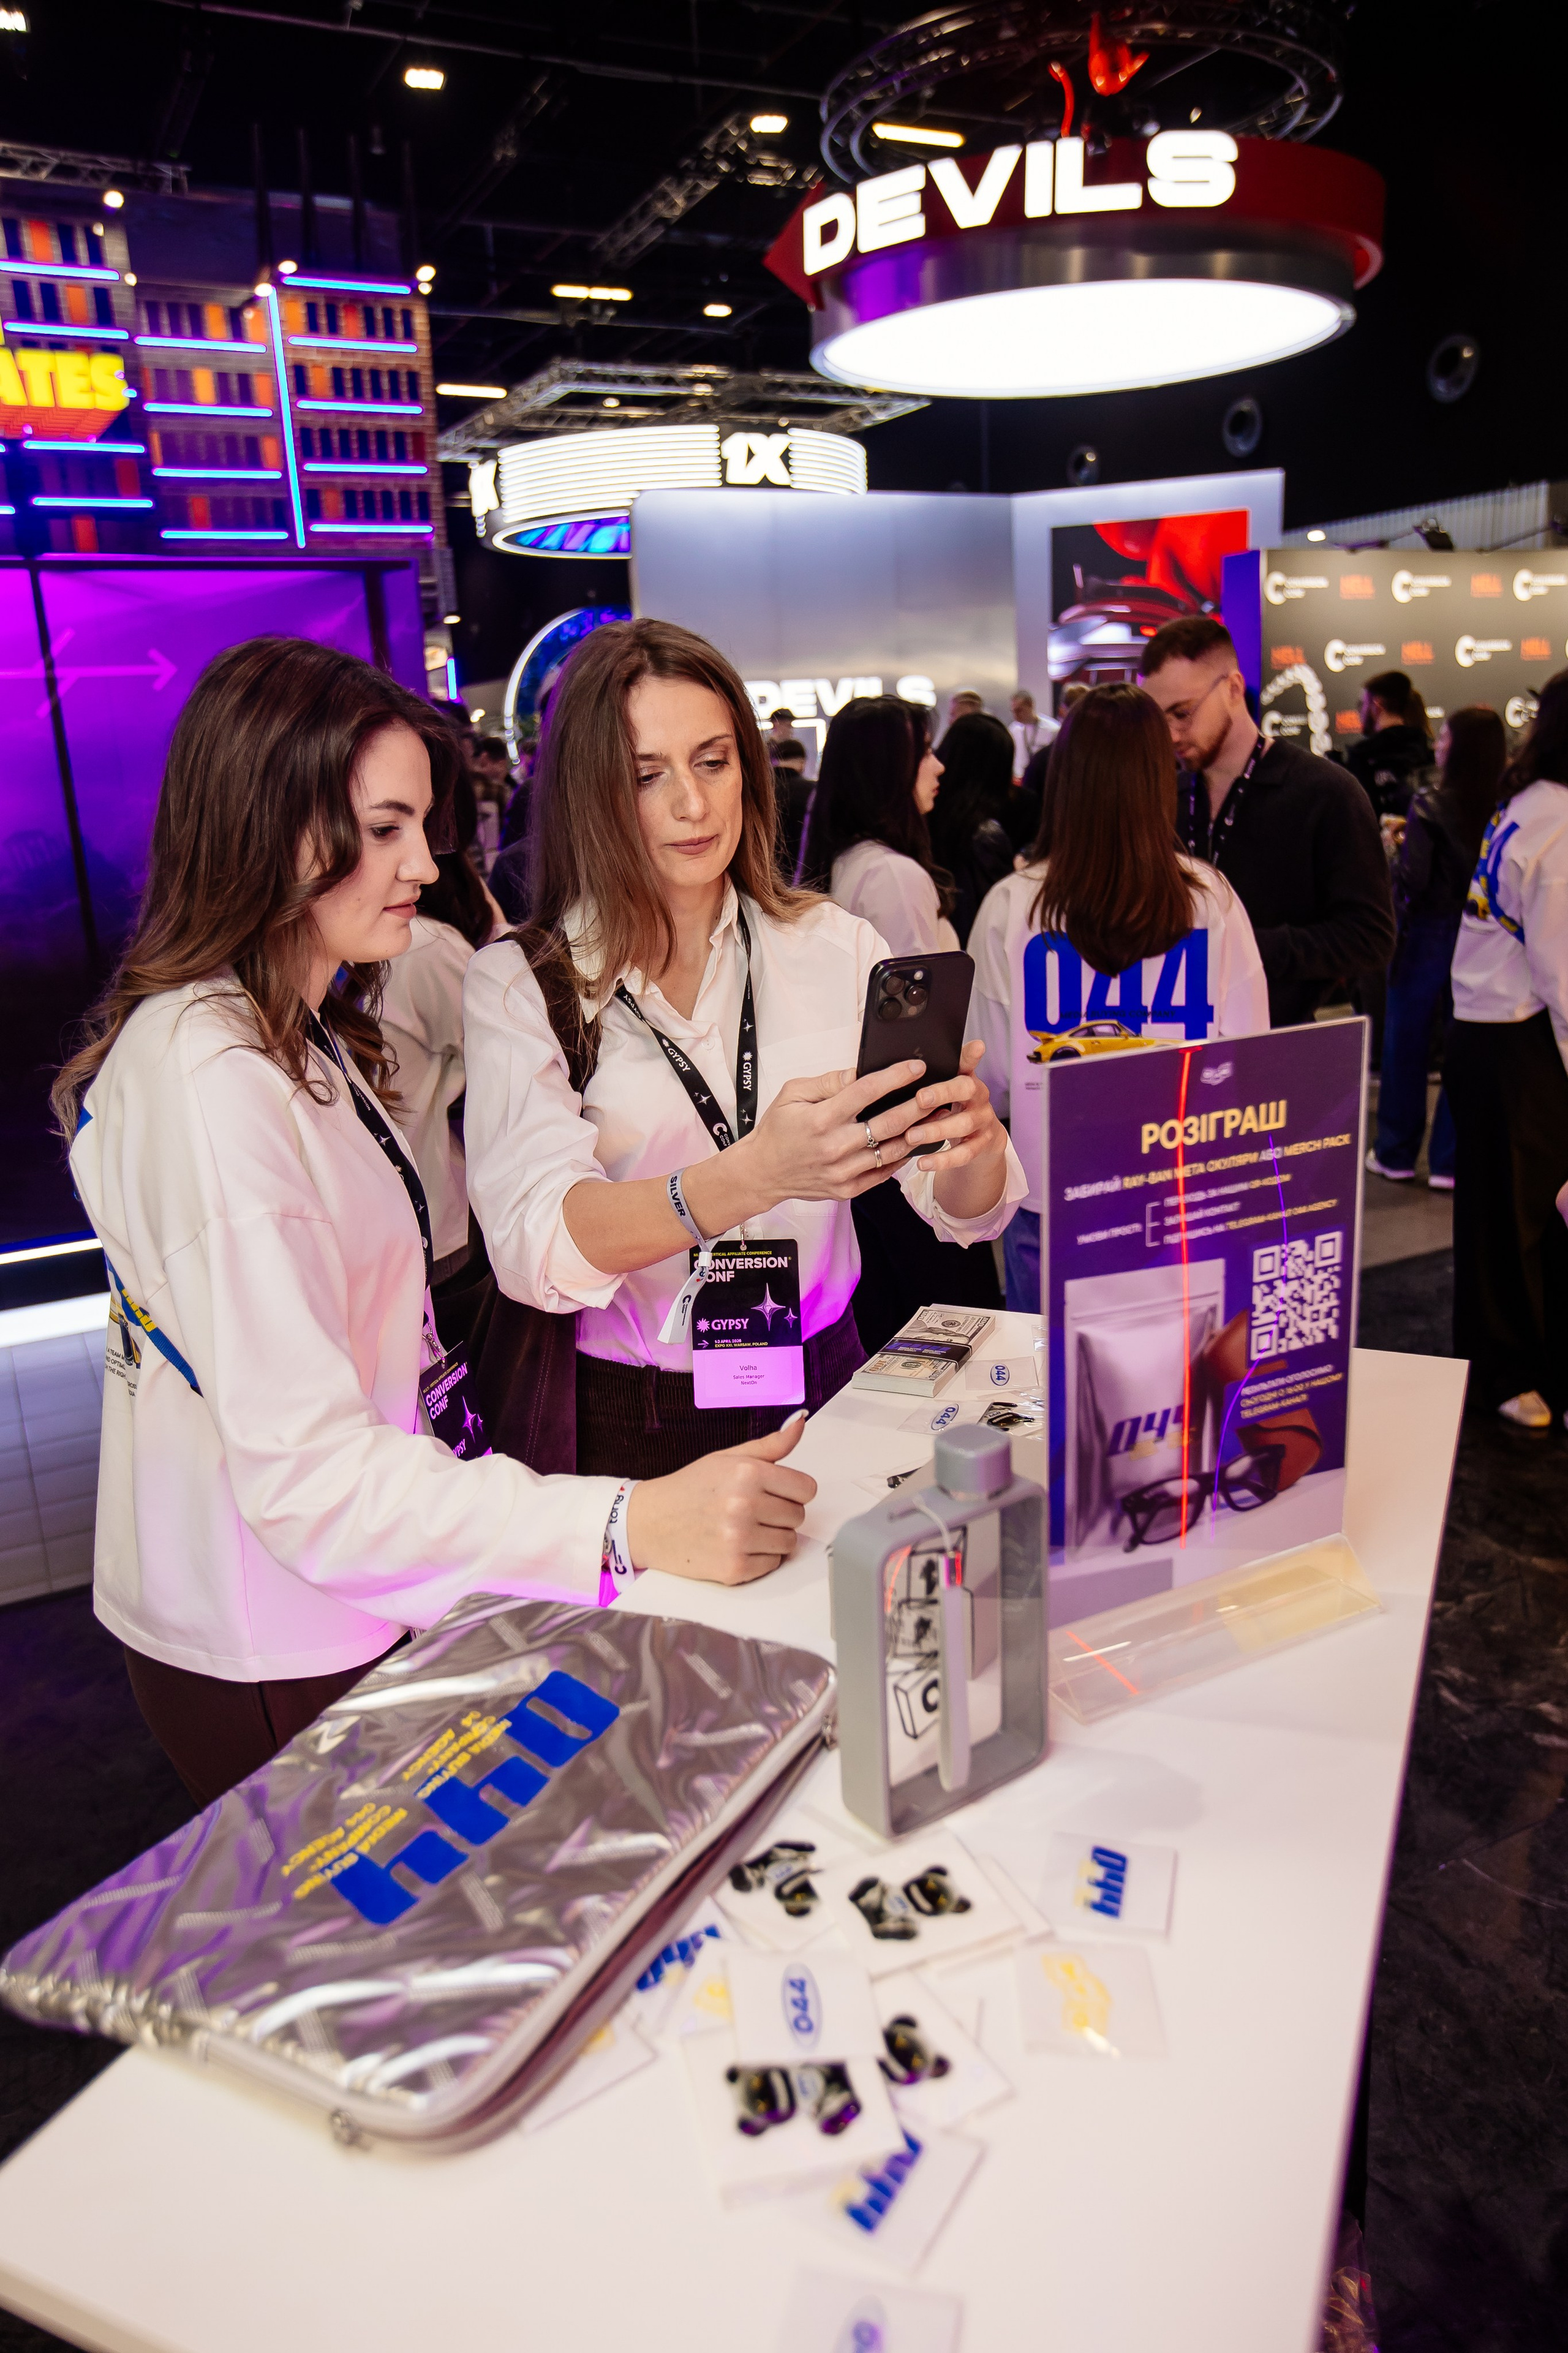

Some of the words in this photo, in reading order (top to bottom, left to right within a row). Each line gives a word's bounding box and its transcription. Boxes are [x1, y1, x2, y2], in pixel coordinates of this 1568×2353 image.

[802, 129, 1239, 276] DEVILS
[668, 1048, 691, 1072] GYPSY
[743, 1062, 752, 1091] GYPSY
[669, 1175, 686, 1217] SILVER
[705, 1271, 735, 1283] ONF
[711, 1318, 749, 1331] GYPSY
[110, 1349, 121, 1358] TEAM
[426, 1362, 468, 1407] CONVERSION
[995, 1365, 1006, 1381] 044
[429, 1395, 448, 1420] CONF
[936, 1407, 956, 1426] 044
[453, 1438, 467, 1458] YPSY
[788, 1977, 814, 2034] 044
